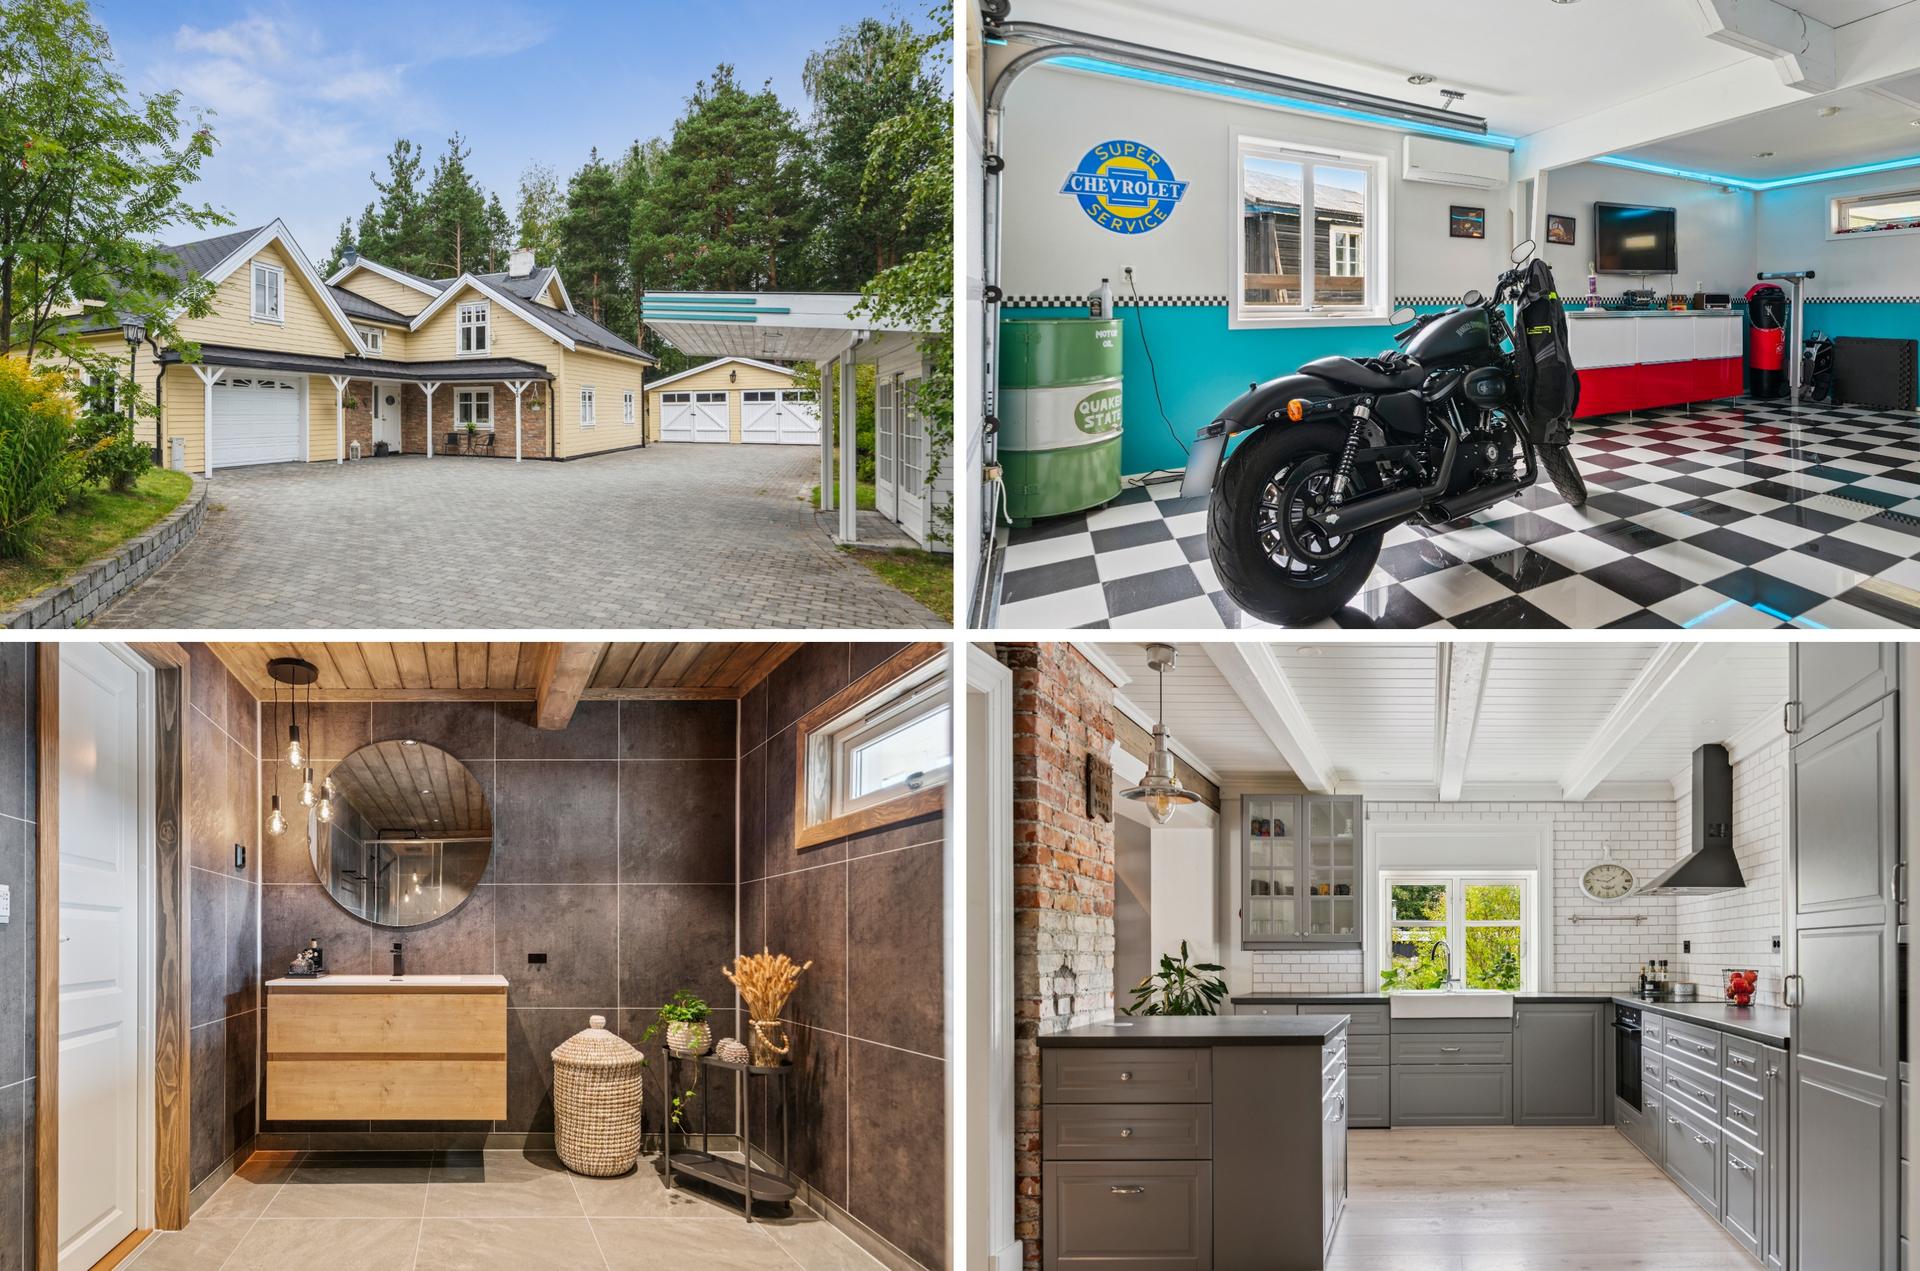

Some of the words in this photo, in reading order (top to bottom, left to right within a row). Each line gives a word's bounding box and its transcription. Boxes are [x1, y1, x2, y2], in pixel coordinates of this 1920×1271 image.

[1094, 143, 1161, 166] SUPER
[1070, 176, 1181, 198] CHEVROLET
[1087, 203, 1168, 232] SERVICE
[1079, 395, 1122, 414] QUAKE
